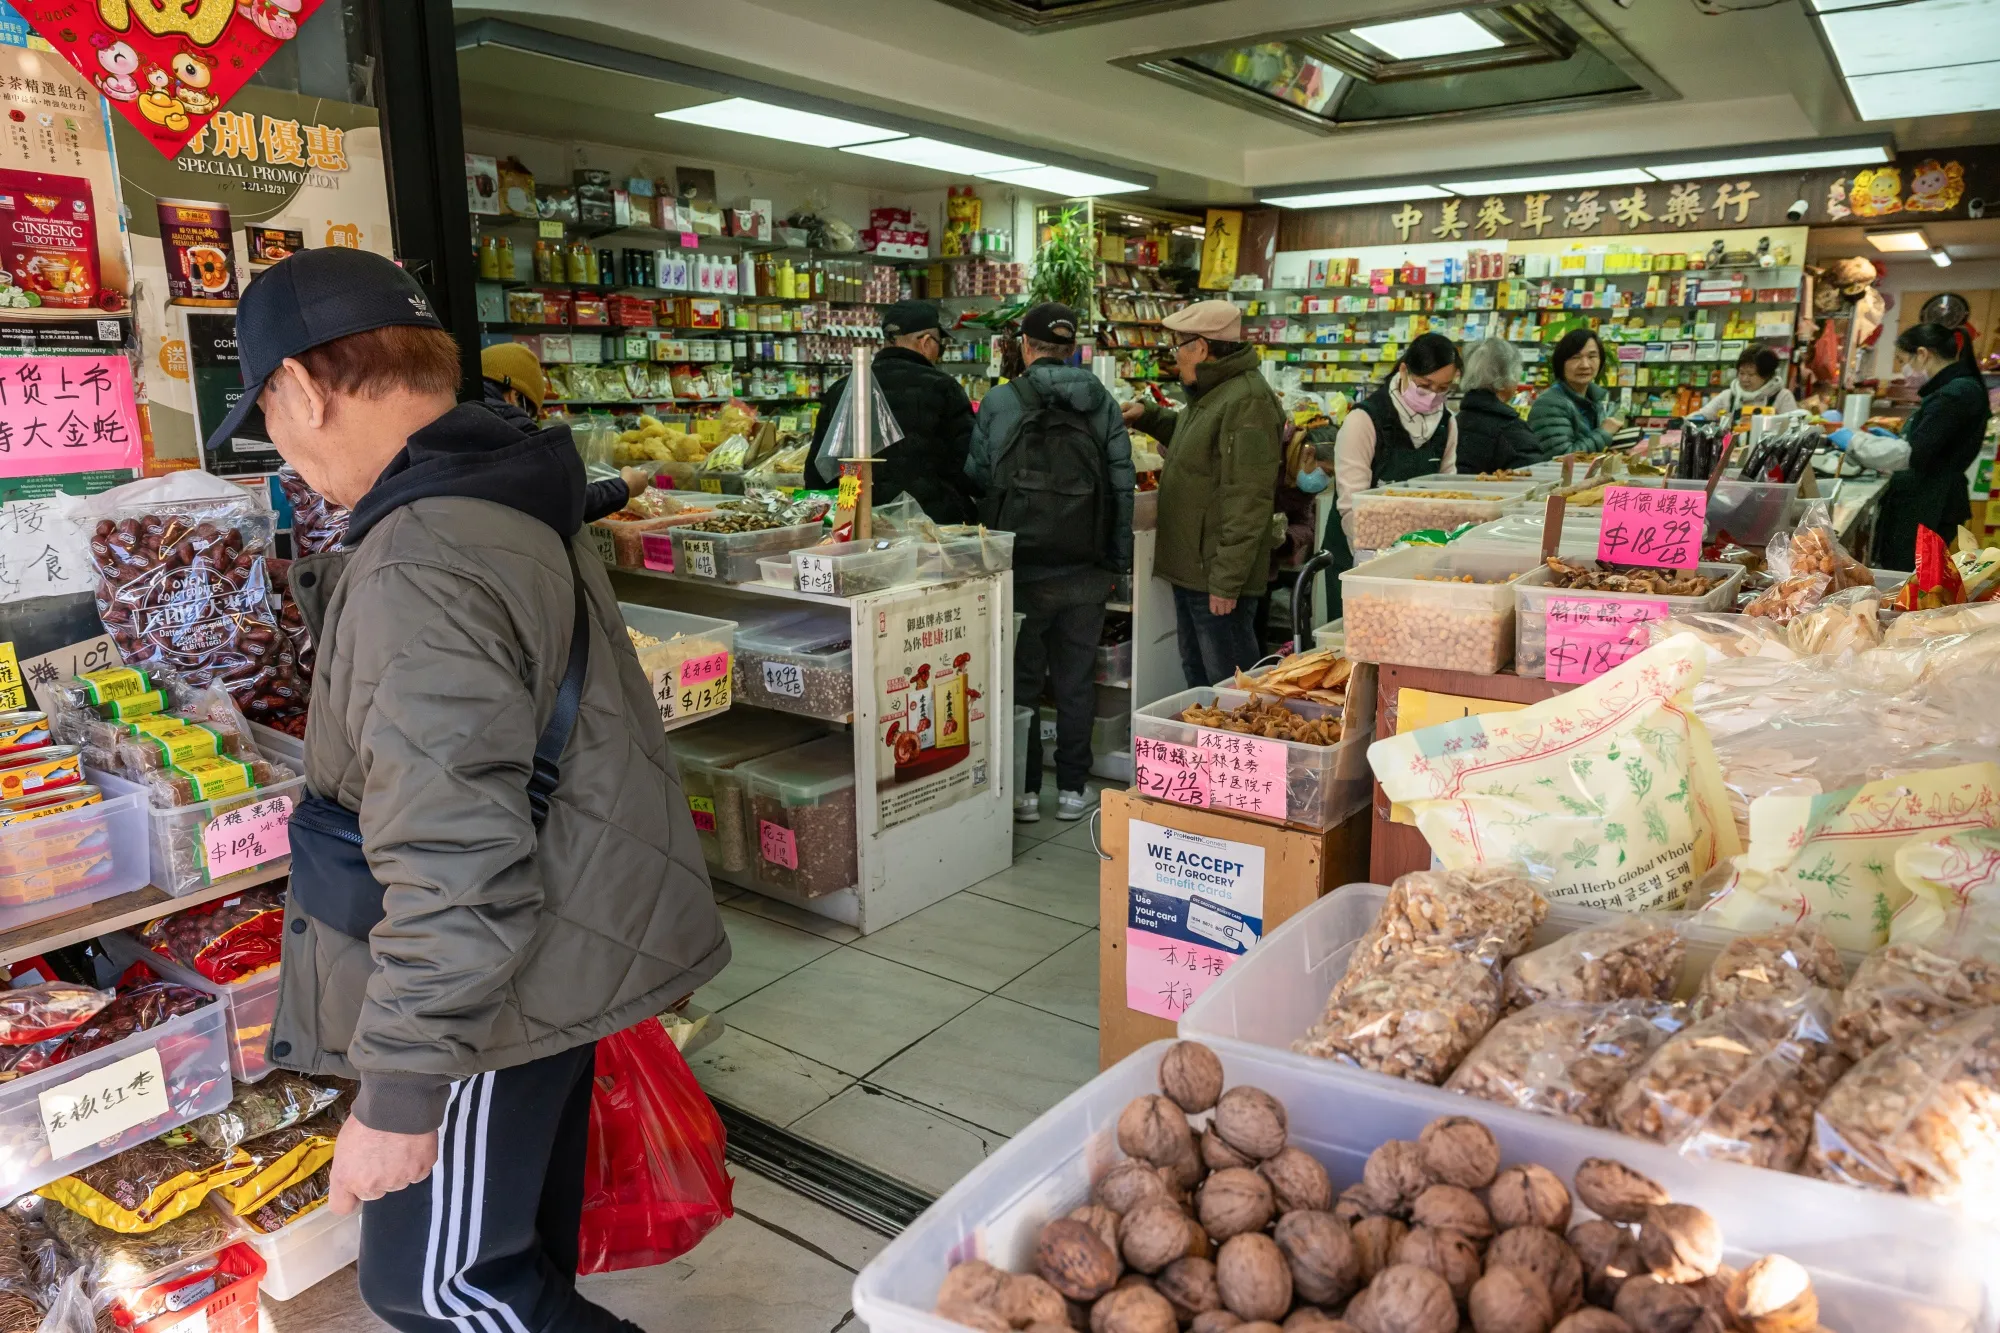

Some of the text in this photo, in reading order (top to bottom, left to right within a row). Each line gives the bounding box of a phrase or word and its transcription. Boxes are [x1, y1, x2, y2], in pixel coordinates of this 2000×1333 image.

[178, 157, 339, 190] SPECIAL PROMOTION
[1390, 180, 1760, 242] 中美參茸海味藥行
[12, 220, 83, 238] GINSENG
[25, 235, 54, 245] ROOT
[55, 237, 77, 247] TEA
[167, 346, 187, 364] 送
[168, 364, 189, 372] FREE
[172, 578, 206, 589] OVEN
[1136, 737, 1209, 775] 特價螺头
[203, 779, 223, 788] BROWN
[1209, 772, 1273, 795] 华医院卡
[1173, 831, 1227, 849] ProHealthConnect
[1147, 843, 1172, 861] WE
[1176, 850, 1244, 877] ACCEPT
[1155, 862, 1176, 874] OTC
[1185, 869, 1235, 888] GROCERY
[1581, 879, 1617, 894] Herb
[1617, 859, 1656, 886] Global
[1624, 874, 1664, 903] 글로벌
[1664, 860, 1692, 884] 도매
[1156, 872, 1233, 899] Benefit Cards
[1135, 894, 1152, 905] Use
[1135, 905, 1177, 923] your card
[1135, 915, 1158, 928] here!
